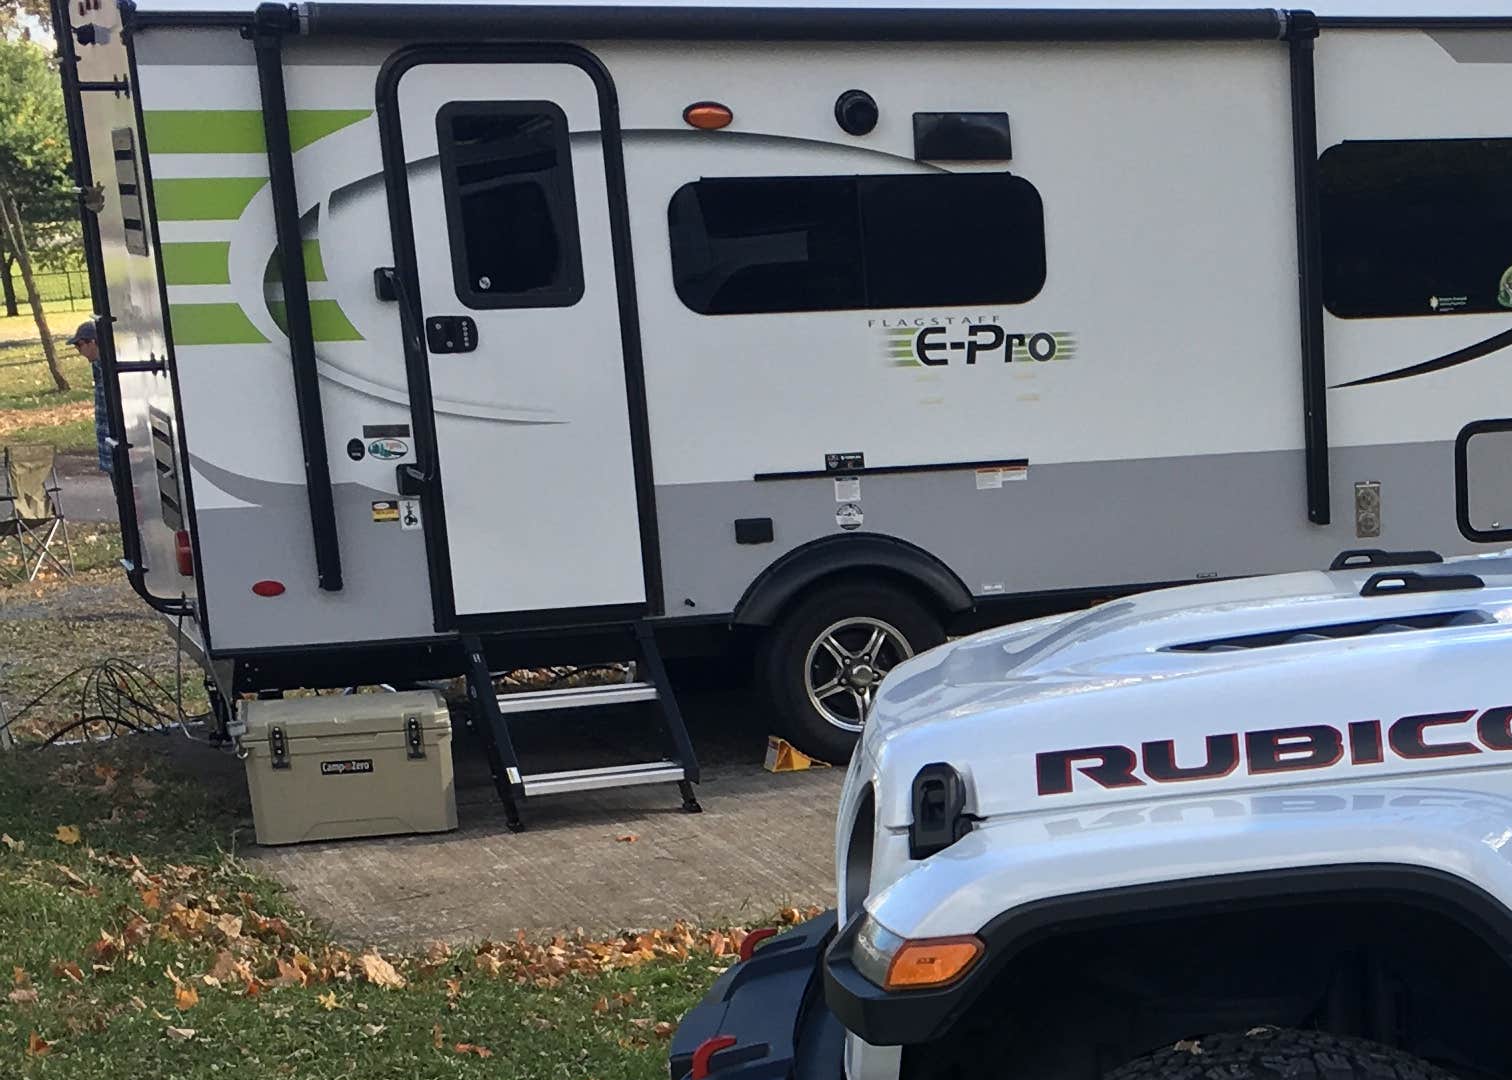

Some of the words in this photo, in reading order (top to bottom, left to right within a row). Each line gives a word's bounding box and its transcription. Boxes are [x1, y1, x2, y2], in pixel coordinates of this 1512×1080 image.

[867, 315, 1000, 328] FLAGSTAFF
[916, 324, 1057, 367] E-Pro
[352, 761, 369, 770] Zero
